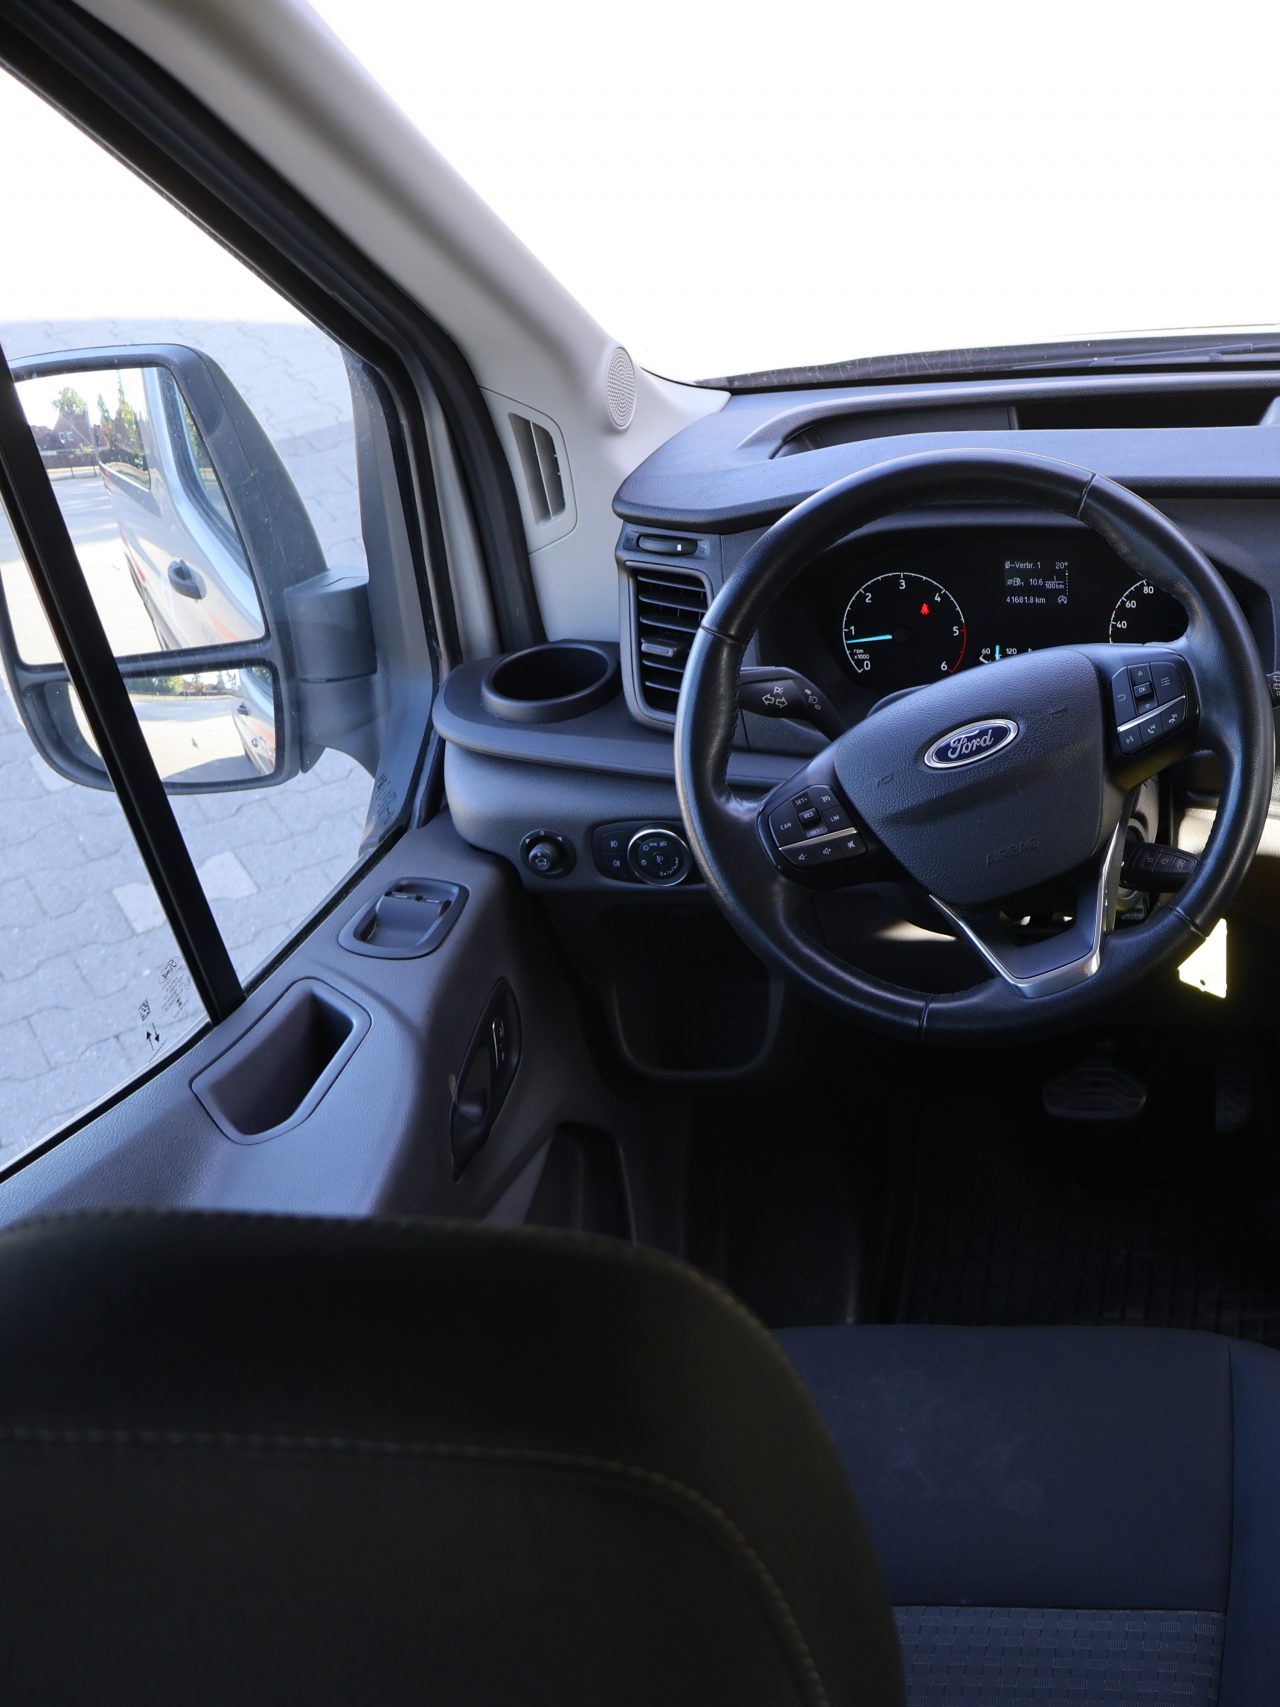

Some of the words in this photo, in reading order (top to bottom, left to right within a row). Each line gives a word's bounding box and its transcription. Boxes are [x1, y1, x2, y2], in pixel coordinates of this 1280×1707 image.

[899, 579, 906, 590] 3
[1029, 578, 1044, 586] 10.6
[1143, 586, 1154, 594] 80
[865, 592, 872, 603] 2
[934, 592, 941, 603] 4
[1006, 595, 1035, 604] 41681.8
[1035, 595, 1046, 604] km
[1125, 600, 1137, 608] 60
[1116, 621, 1128, 629] 40
[849, 625, 855, 636] 1
[952, 626, 959, 636] 5
[981, 647, 991, 655] 60
[1006, 647, 1017, 655] 120
[863, 660, 871, 671] 0
[940, 660, 948, 671] 6
[947, 729, 994, 759] Ford
